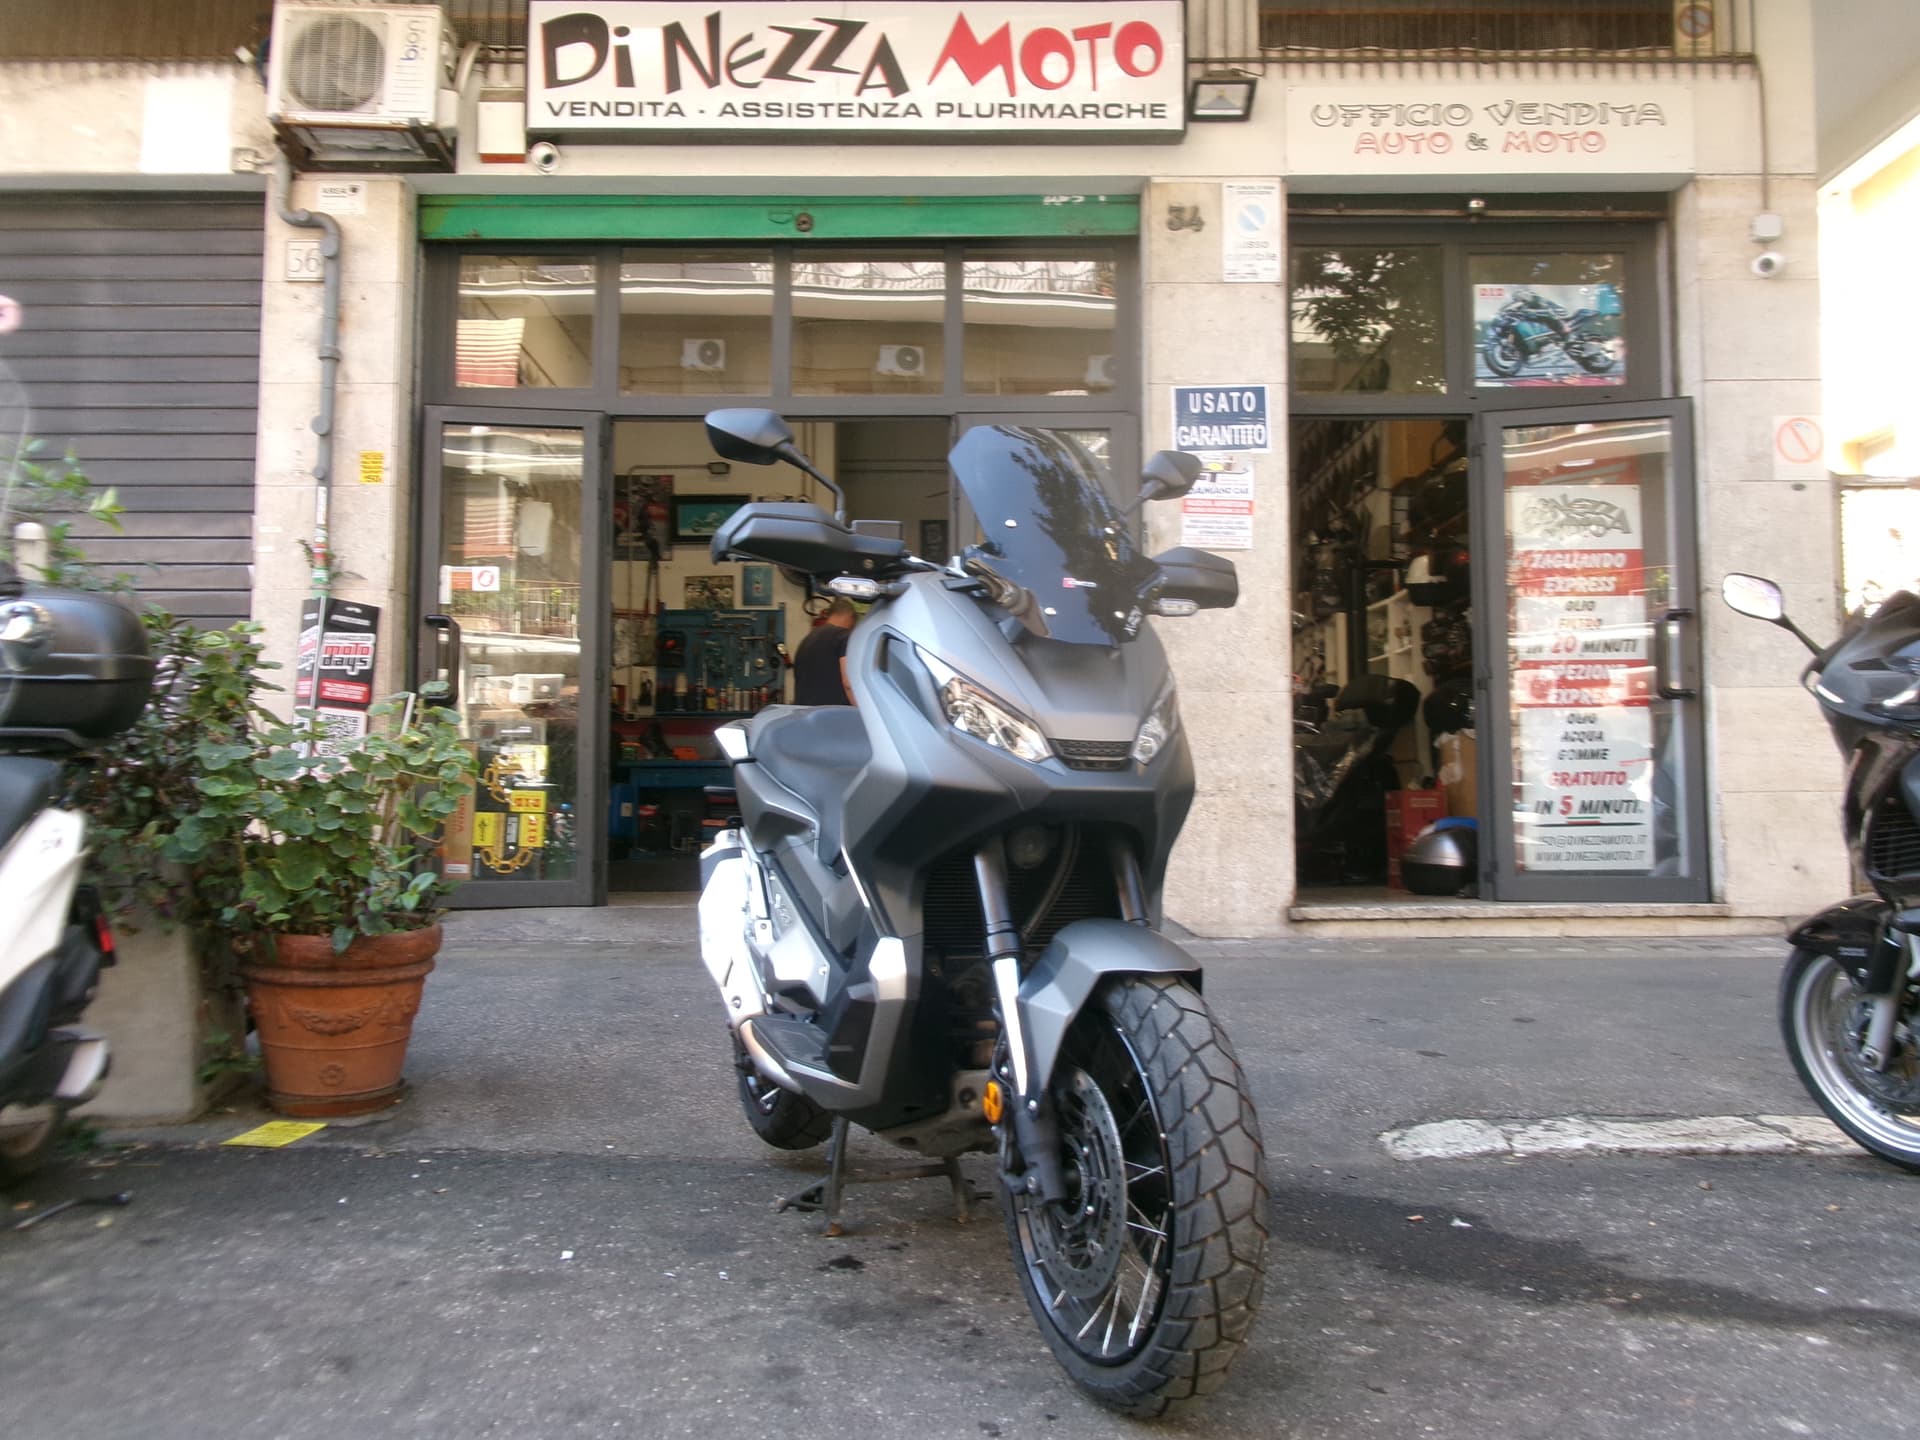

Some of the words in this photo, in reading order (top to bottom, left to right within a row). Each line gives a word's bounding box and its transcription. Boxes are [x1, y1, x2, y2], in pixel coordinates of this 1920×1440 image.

[662, 9, 911, 97] NEZZA
[927, 11, 1165, 98] MOTO
[546, 101, 686, 117] VENDITA
[717, 101, 923, 118] ASSISTENZA
[936, 101, 1168, 119] PLURIMARCHE
[1311, 103, 1472, 127] UFFICIO
[1485, 100, 1667, 127] VENDITA
[1354, 132, 1452, 155] AUTO
[1466, 133, 1489, 153] &
[1502, 131, 1606, 154] MOTO
[1167, 206, 1206, 233] 34
[1188, 392, 1257, 413] USATO
[1178, 424, 1266, 446] GARANTITO
[1543, 576, 1617, 593] EXPRESS
[1580, 638, 1638, 653] MINUTI
[1560, 729, 1605, 743] ACQUA
[1548, 771, 1628, 787] GRATUITO
[1534, 799, 1554, 815] IN
[1559, 795, 1573, 815] 5
